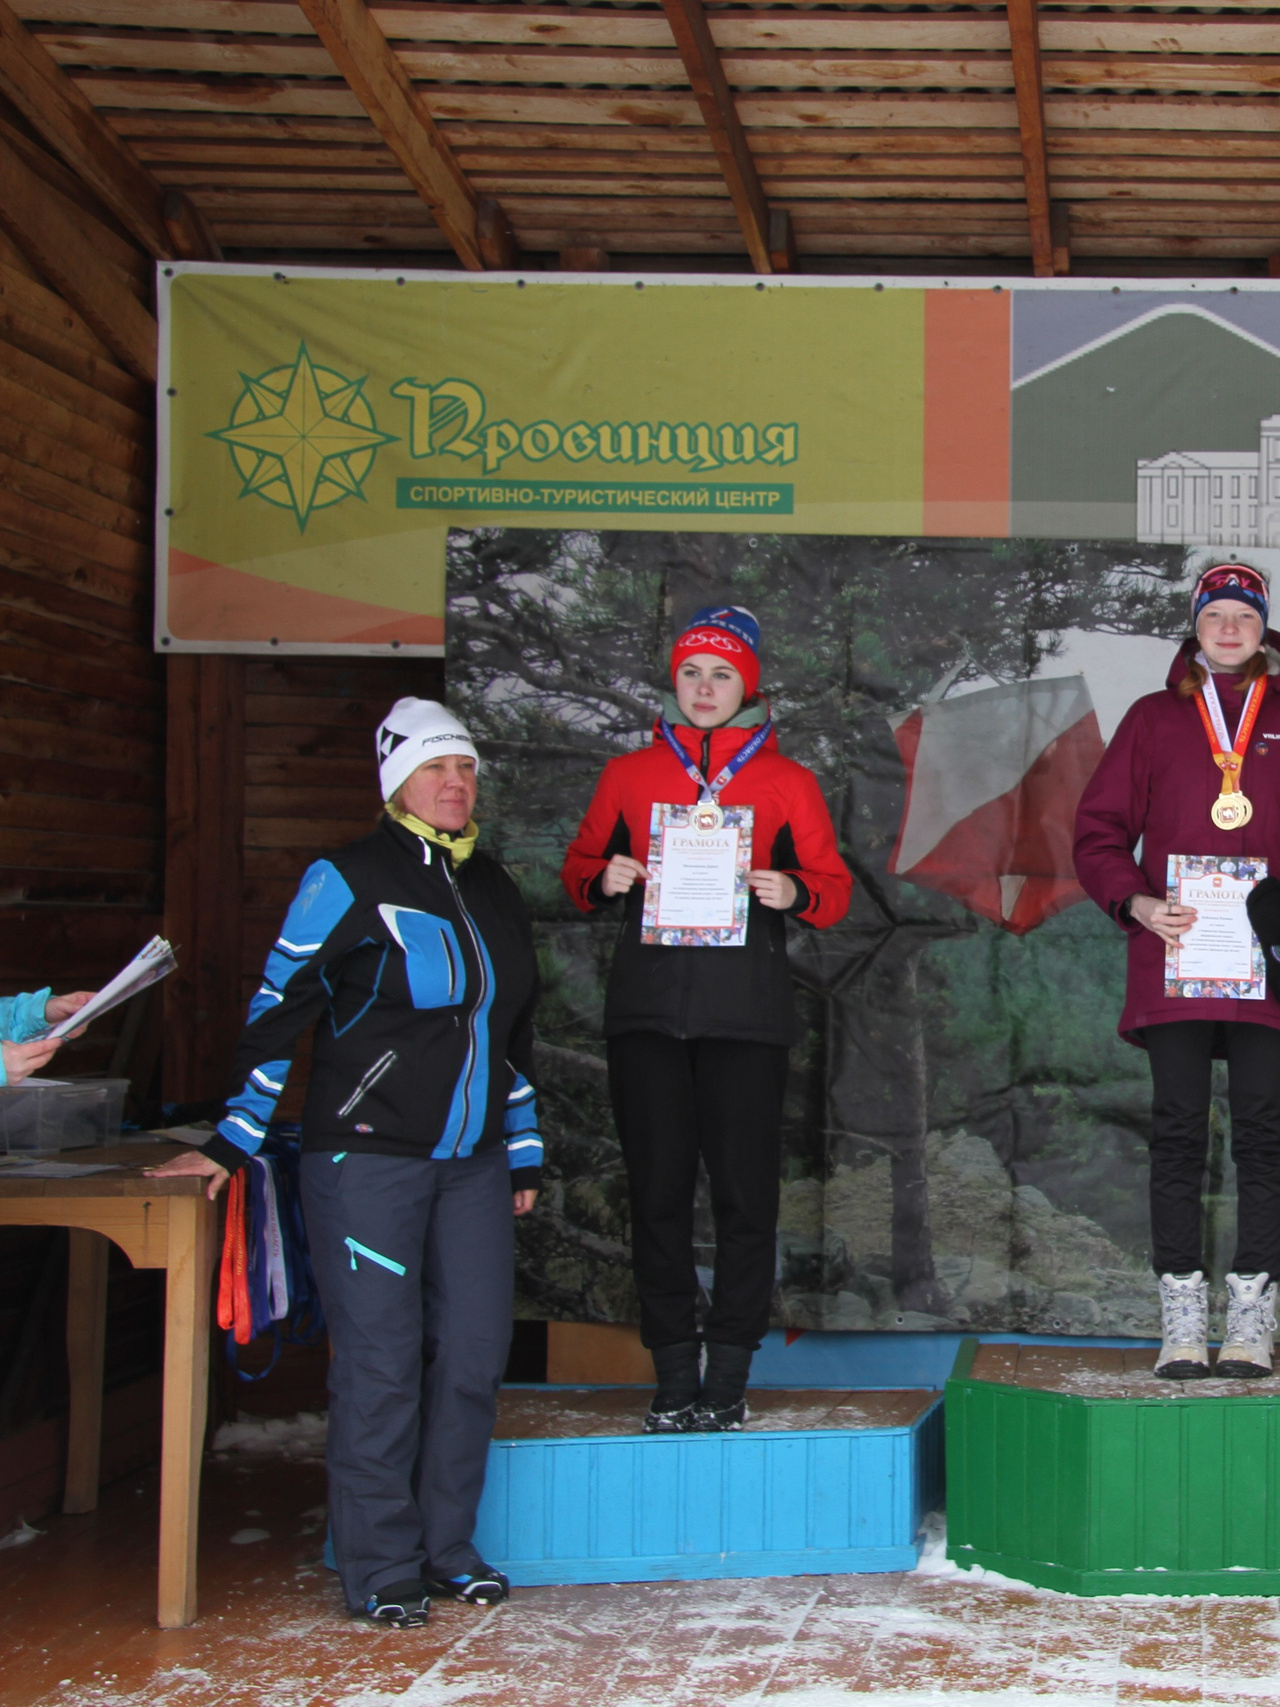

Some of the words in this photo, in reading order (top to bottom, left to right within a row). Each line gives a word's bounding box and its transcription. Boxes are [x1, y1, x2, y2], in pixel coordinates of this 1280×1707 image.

[389, 376, 799, 475] Провинция
[410, 486, 710, 506] СПОРТИВНО-ТУРИСТИЧЕСКИЙ
[715, 490, 781, 509] ЦЕНТР
[1239, 711, 1253, 743] ОБЛАСТЬ
[672, 838, 730, 848] ГРАМОТА
[1188, 889, 1245, 900] ГРАМОТА
